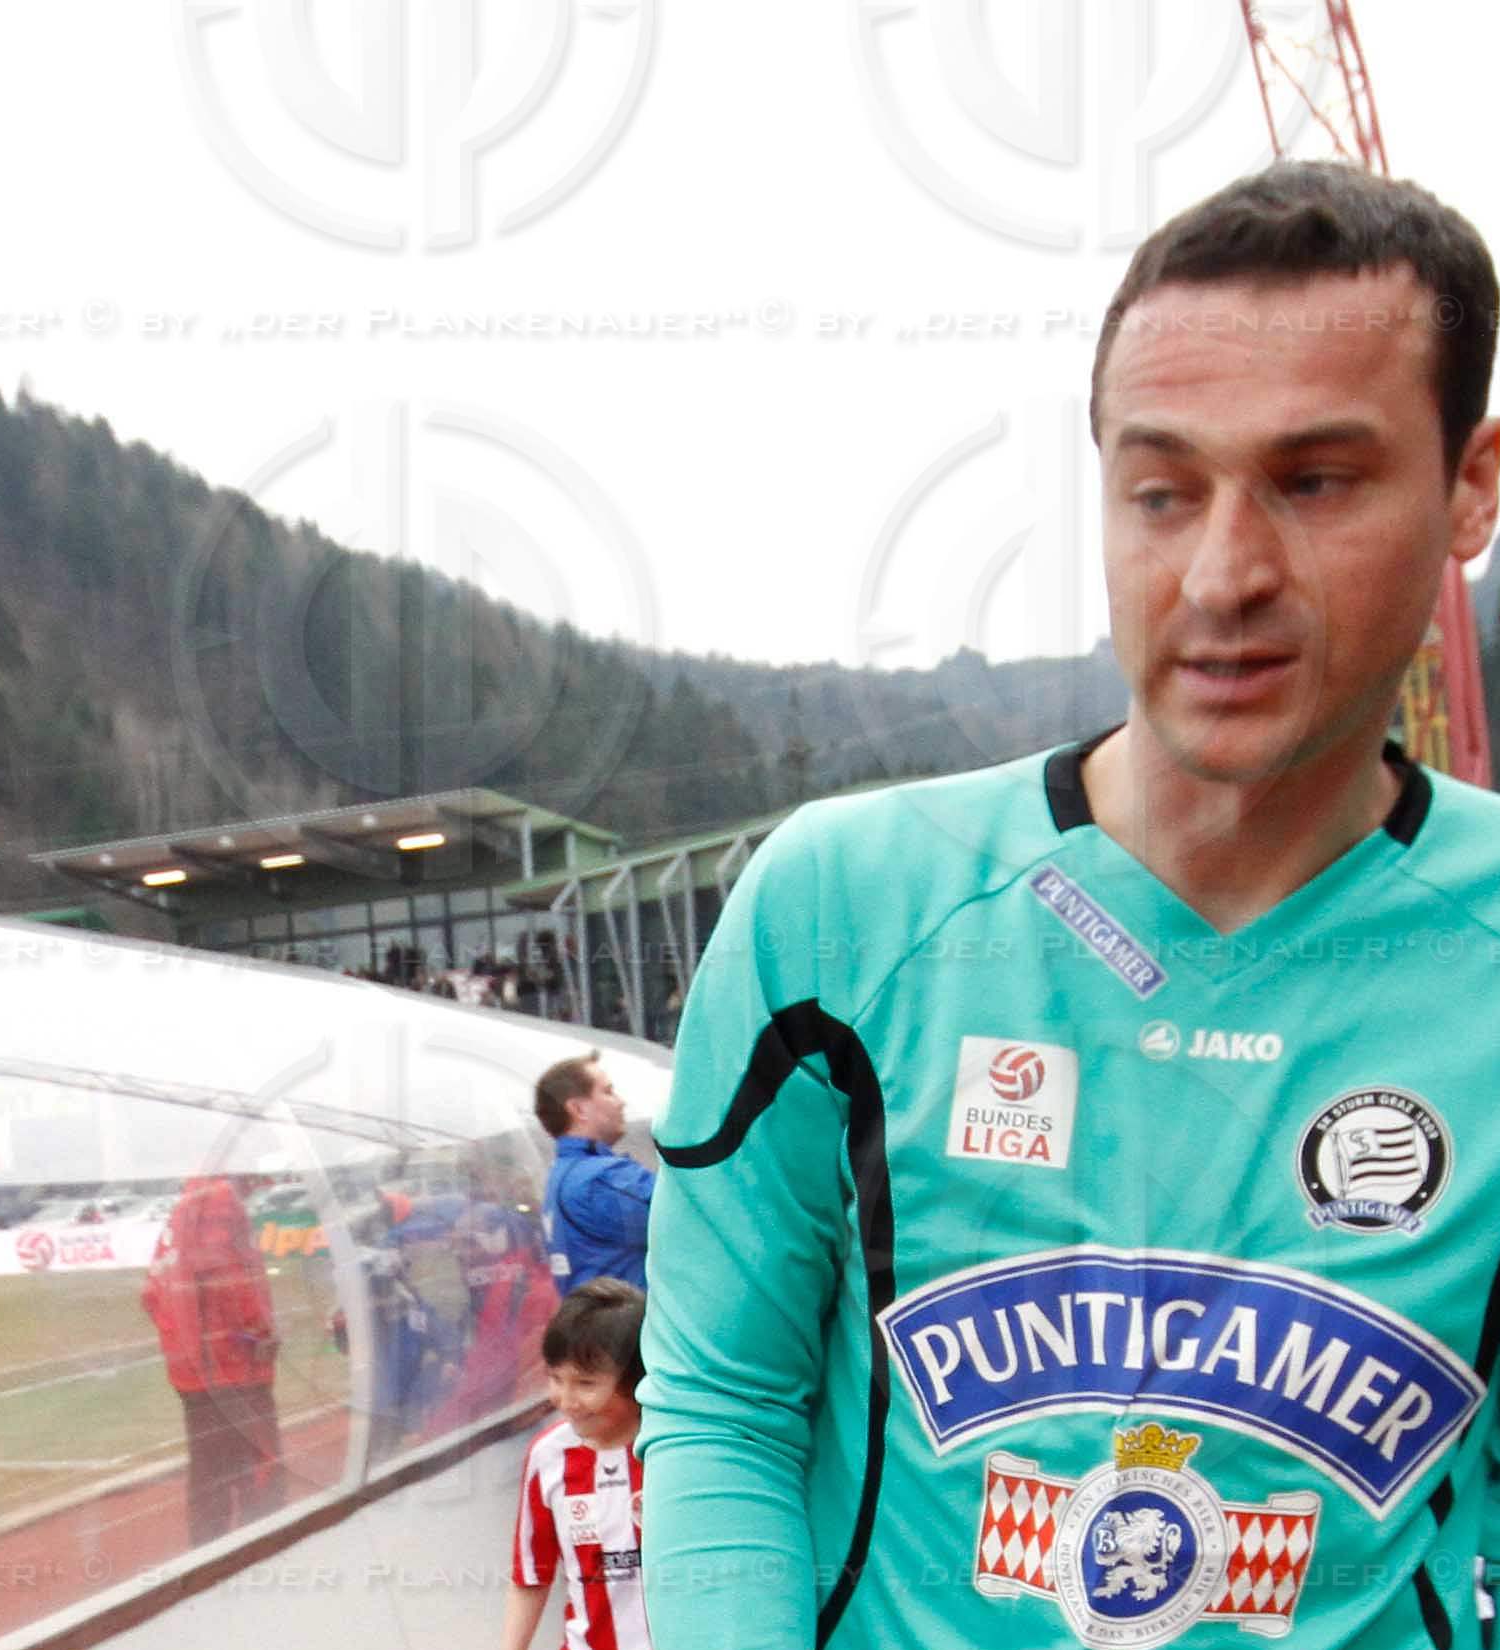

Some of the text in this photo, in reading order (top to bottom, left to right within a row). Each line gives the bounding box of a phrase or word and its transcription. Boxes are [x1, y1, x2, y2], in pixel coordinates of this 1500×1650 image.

[1037, 872, 1157, 989] PUNTIGAMER
[1186, 1029, 1285, 1062] JAKO
[965, 1106, 1053, 1133] BUNDES
[962, 1125, 1051, 1162] LIGA
[910, 1291, 1434, 1463] PUNTIGAMER
